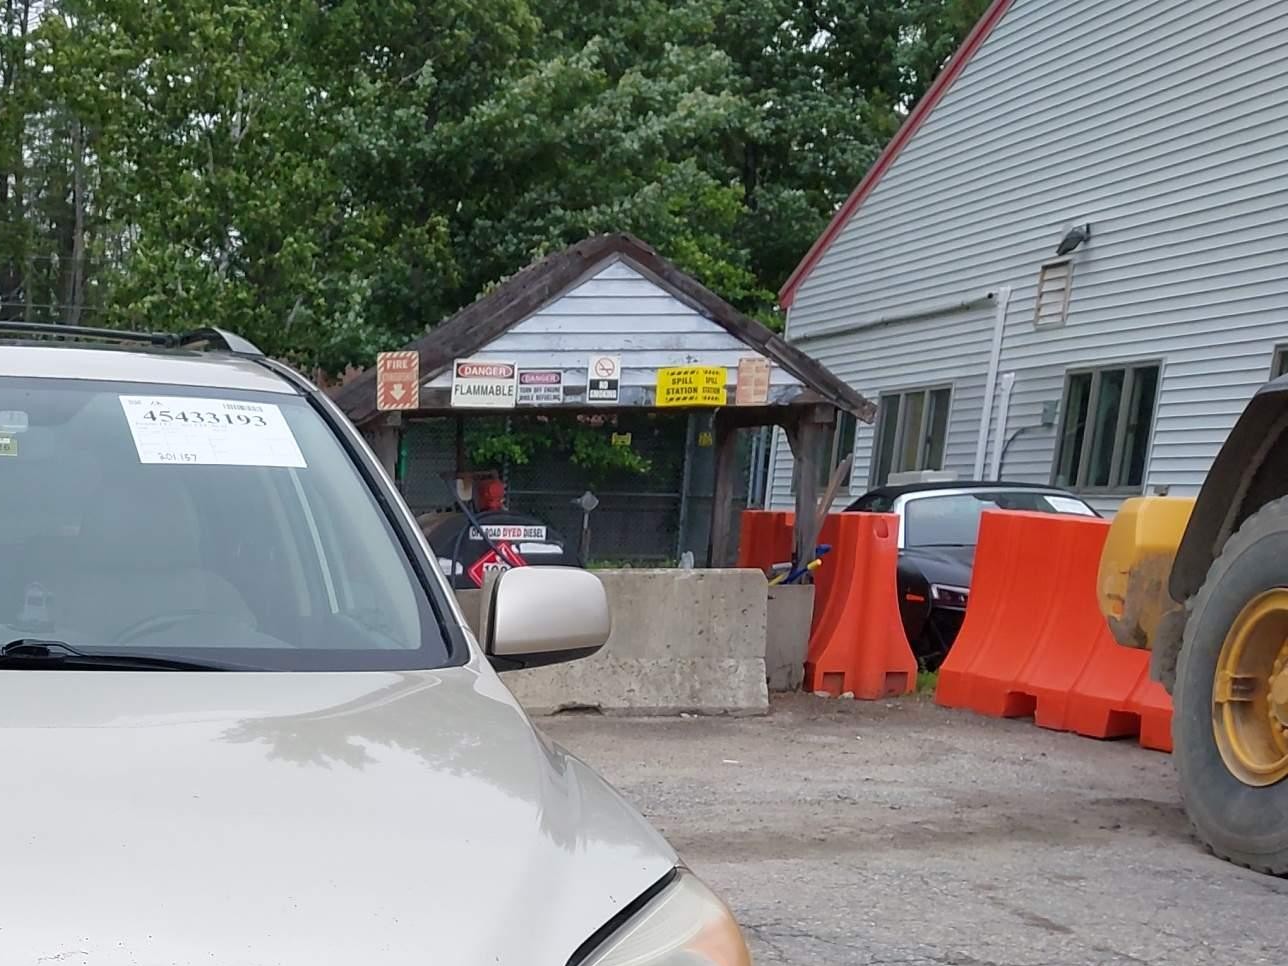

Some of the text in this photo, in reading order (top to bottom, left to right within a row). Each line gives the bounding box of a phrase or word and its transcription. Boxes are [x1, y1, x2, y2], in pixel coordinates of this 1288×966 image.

[386, 359, 409, 369] FIRE
[463, 365, 507, 376] DANGER
[525, 374, 556, 383] DANGER
[671, 377, 693, 385] SPILL
[454, 384, 514, 396] FLAMMABLE
[666, 387, 697, 395] STATION
[143, 410, 267, 427] 45433193
[502, 527, 522, 537] DYED
[523, 528, 544, 538] DIESEL
